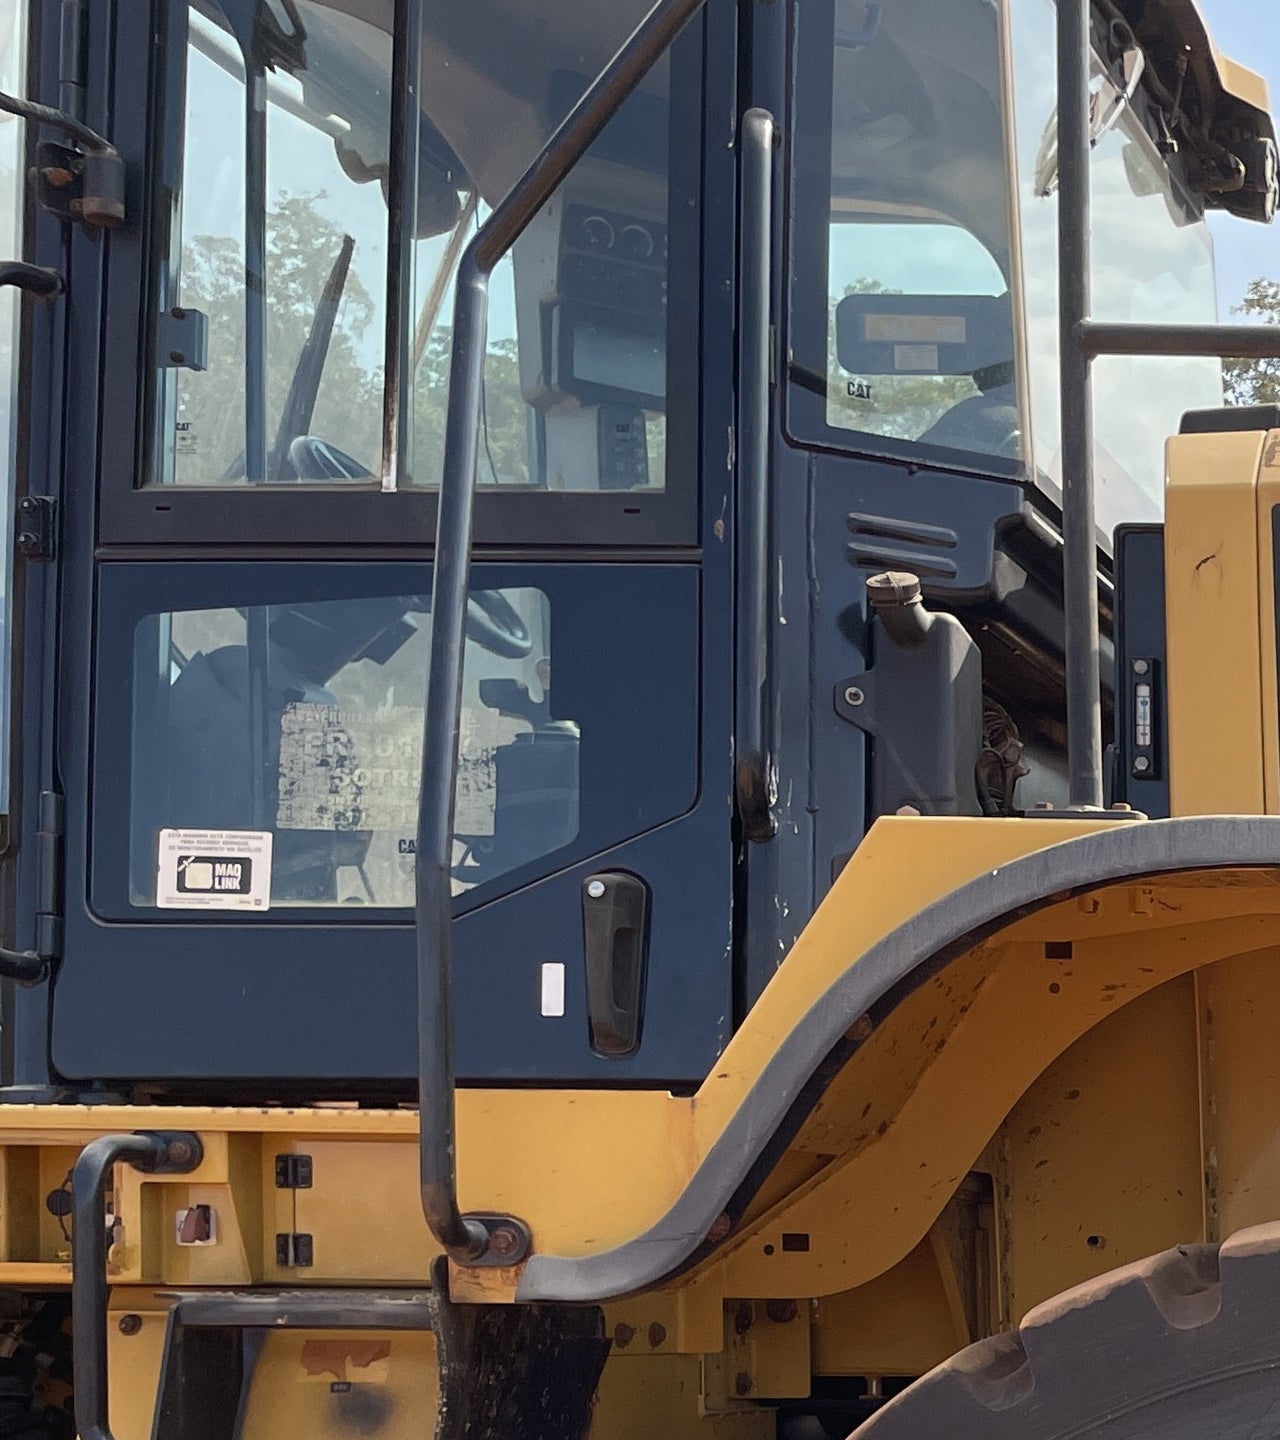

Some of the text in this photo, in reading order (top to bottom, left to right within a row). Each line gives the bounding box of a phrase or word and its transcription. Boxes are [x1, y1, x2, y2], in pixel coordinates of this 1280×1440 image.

[847, 381, 873, 399] CAT
[398, 838, 417, 854] CA
[215, 877, 241, 890] LINK
